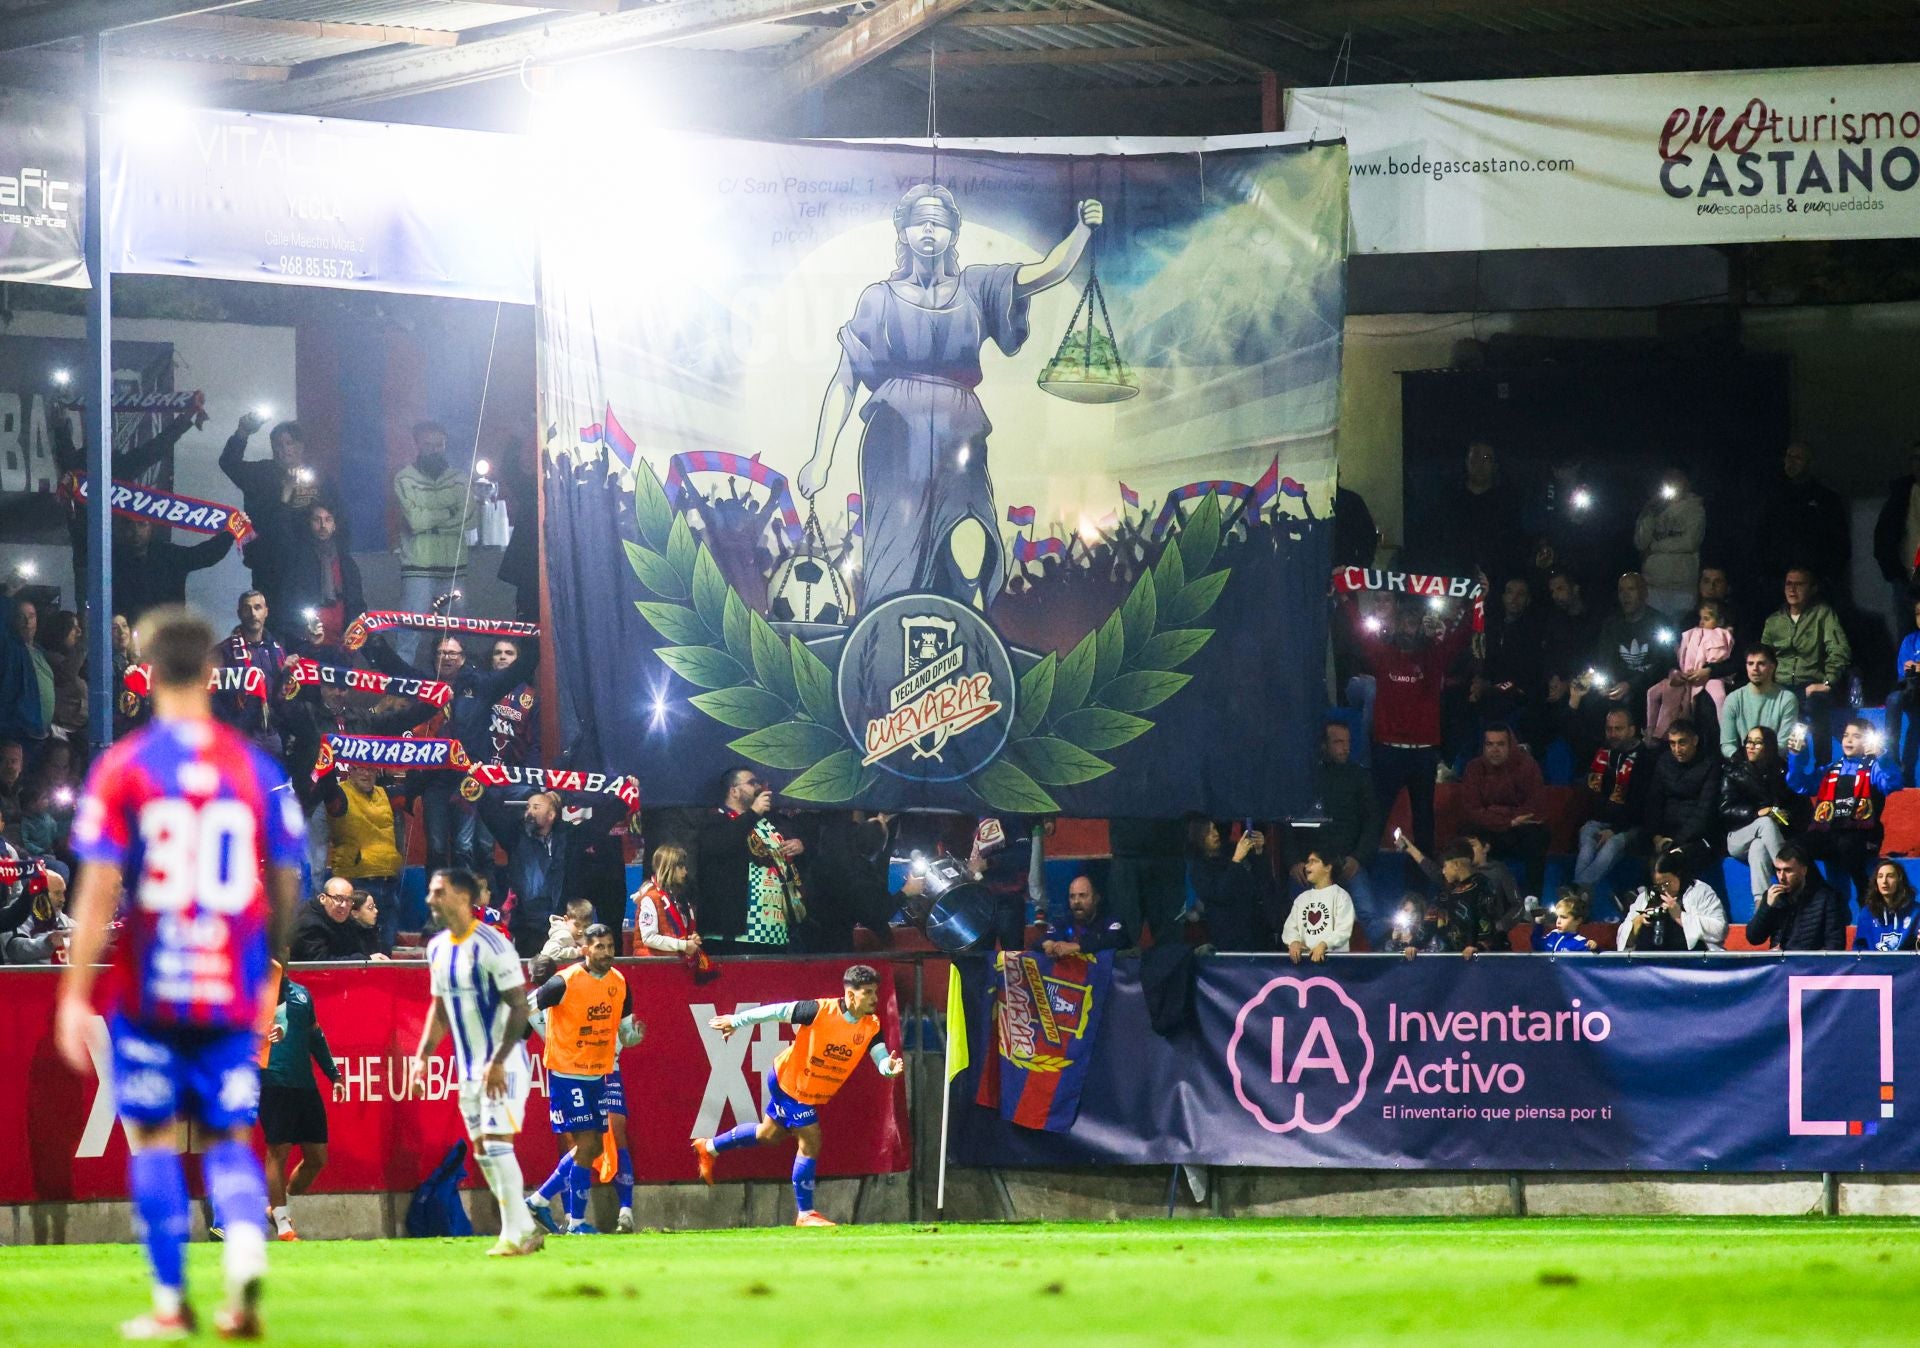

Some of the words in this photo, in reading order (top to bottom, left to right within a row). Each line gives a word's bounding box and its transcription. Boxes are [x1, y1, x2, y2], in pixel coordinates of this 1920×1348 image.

[1660, 136, 1920, 198] CASTAÑO
[743, 177, 778, 193] San
[1697, 200, 1782, 218] enoescapadas
[1786, 199, 1797, 212] &
[1803, 199, 1885, 215] enoquedadas
[265, 230, 289, 246] Calle
[291, 231, 329, 249] Maestro
[280, 255, 302, 275] 968
[305, 257, 320, 276] 85
[322, 259, 337, 277] 55
[340, 260, 353, 279] 73
[80, 479, 226, 529] RVABAR
[137, 666, 261, 690] YANO
[344, 671, 451, 705] YECLANO
[895, 669, 931, 704] YECLANO
[867, 675, 991, 752] CURVABAR
[330, 736, 448, 763] CURVABAR
[480, 764, 640, 804] CURVABAR
[136, 797, 257, 915] 30
[1388, 998, 1611, 1042] Inventario
[1270, 1016, 1349, 1083] IA
[332, 1056, 381, 1102] THE
[1384, 1050, 1526, 1094] Activo
[571, 1088, 584, 1107] 3
[1382, 1105, 1396, 1119] El
[1400, 1104, 1477, 1119] inventario
[1481, 1107, 1511, 1121] que
[1515, 1104, 1566, 1121] piensa
[1570, 1107, 1597, 1122] por
[1601, 1105, 1612, 1120] ti
